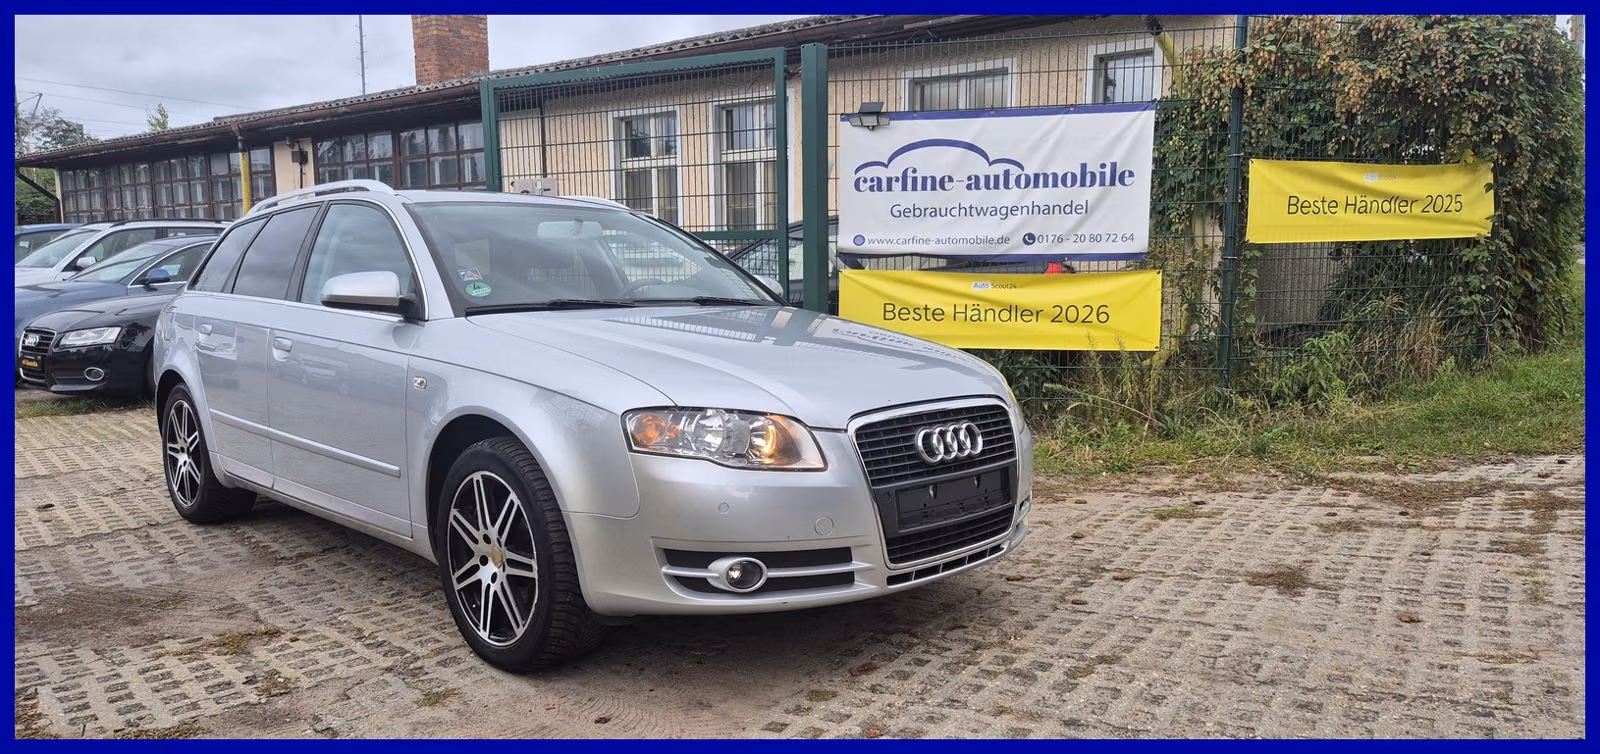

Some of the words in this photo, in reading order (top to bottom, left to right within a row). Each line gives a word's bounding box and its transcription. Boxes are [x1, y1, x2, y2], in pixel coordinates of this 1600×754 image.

[853, 161, 1135, 193] carfine-automobile
[889, 200, 1089, 220] Gebrauchtwagenhandel
[1287, 195, 1339, 215] Beste
[1344, 194, 1419, 214] Händler
[1421, 194, 1463, 213] 2025
[867, 234, 1011, 246] www.carfine-automobile.de
[1037, 233, 1064, 244] 0176
[1073, 233, 1086, 243] 20
[1089, 233, 1102, 243] 80
[1105, 233, 1118, 243] 72
[1121, 233, 1135, 243] 64
[882, 303, 945, 322] Beste
[952, 303, 1044, 323] Händler
[1050, 305, 1110, 324] 2026
